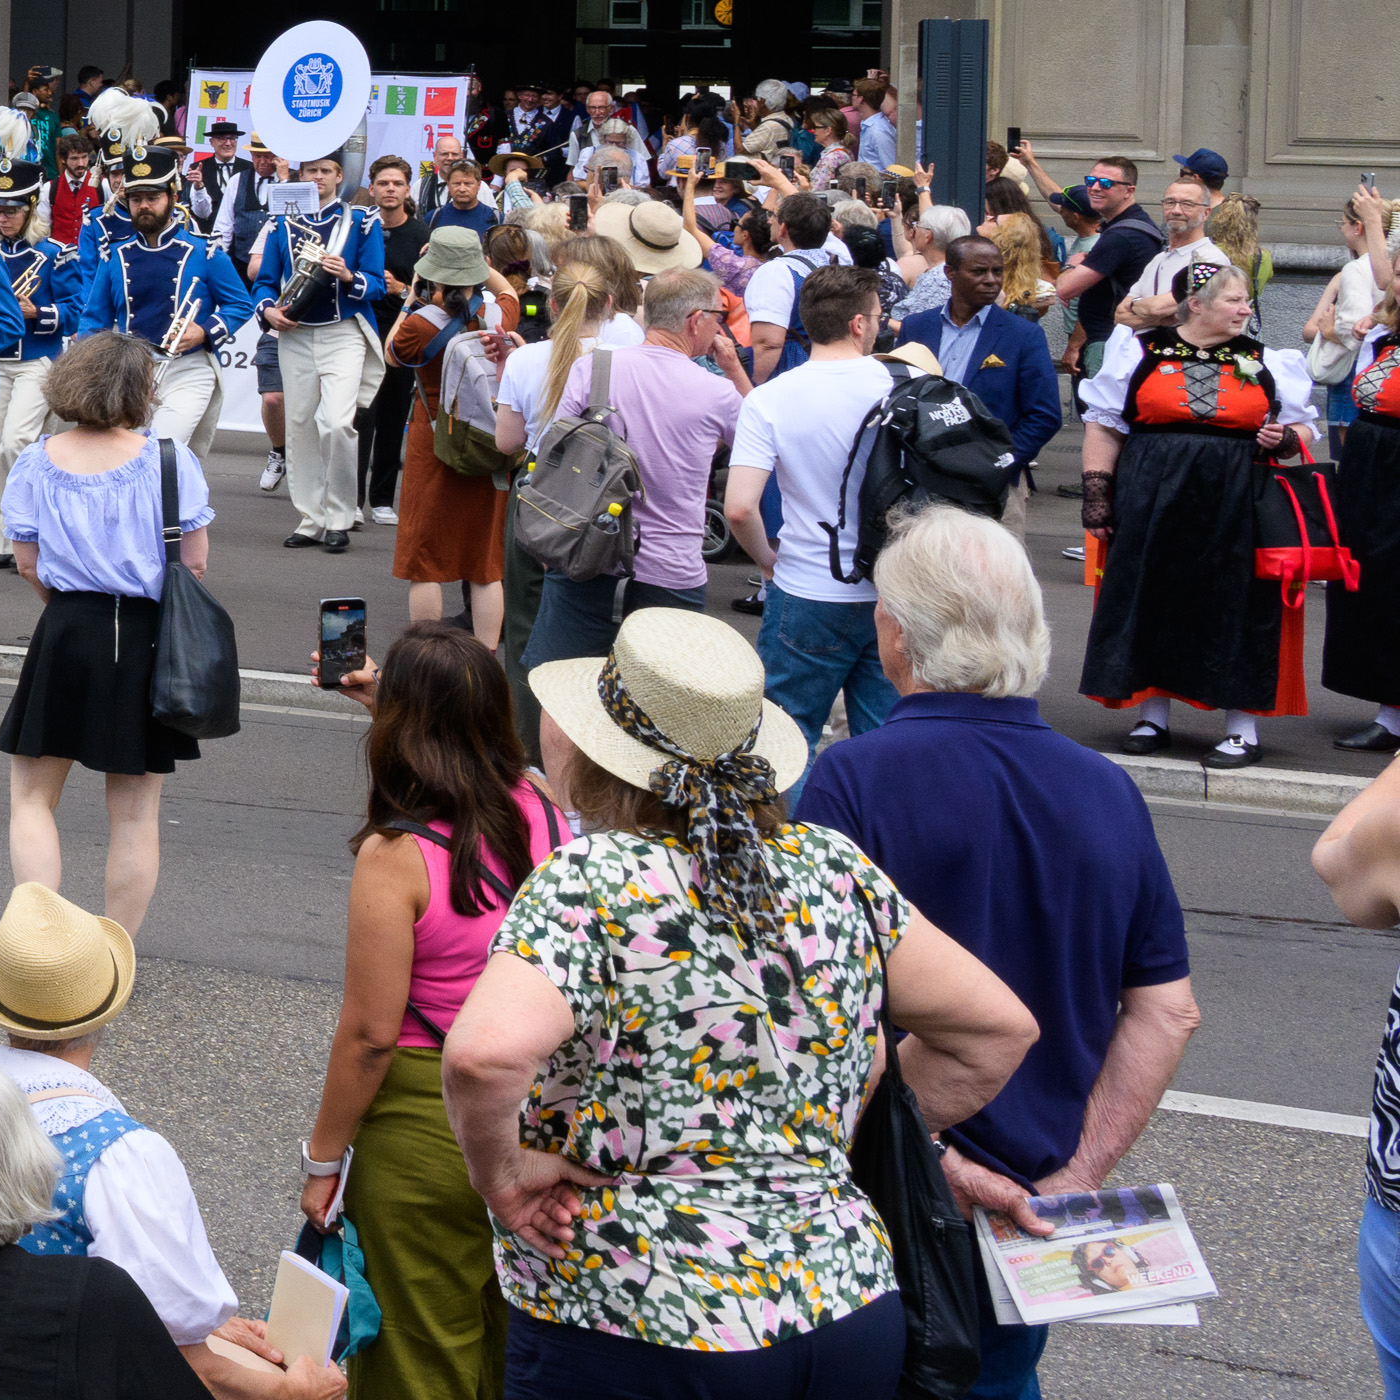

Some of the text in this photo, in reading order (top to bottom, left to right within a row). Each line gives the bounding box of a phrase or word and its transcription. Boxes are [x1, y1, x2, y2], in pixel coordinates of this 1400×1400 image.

[291, 98, 331, 109] STADTMUSIK
[298, 107, 323, 118] ZÜRICH
[928, 407, 962, 421] NORTH
[944, 414, 966, 427] FACE
[1008, 1254, 1035, 1265] coop
[1126, 1263, 1193, 1285] WEEKEND
